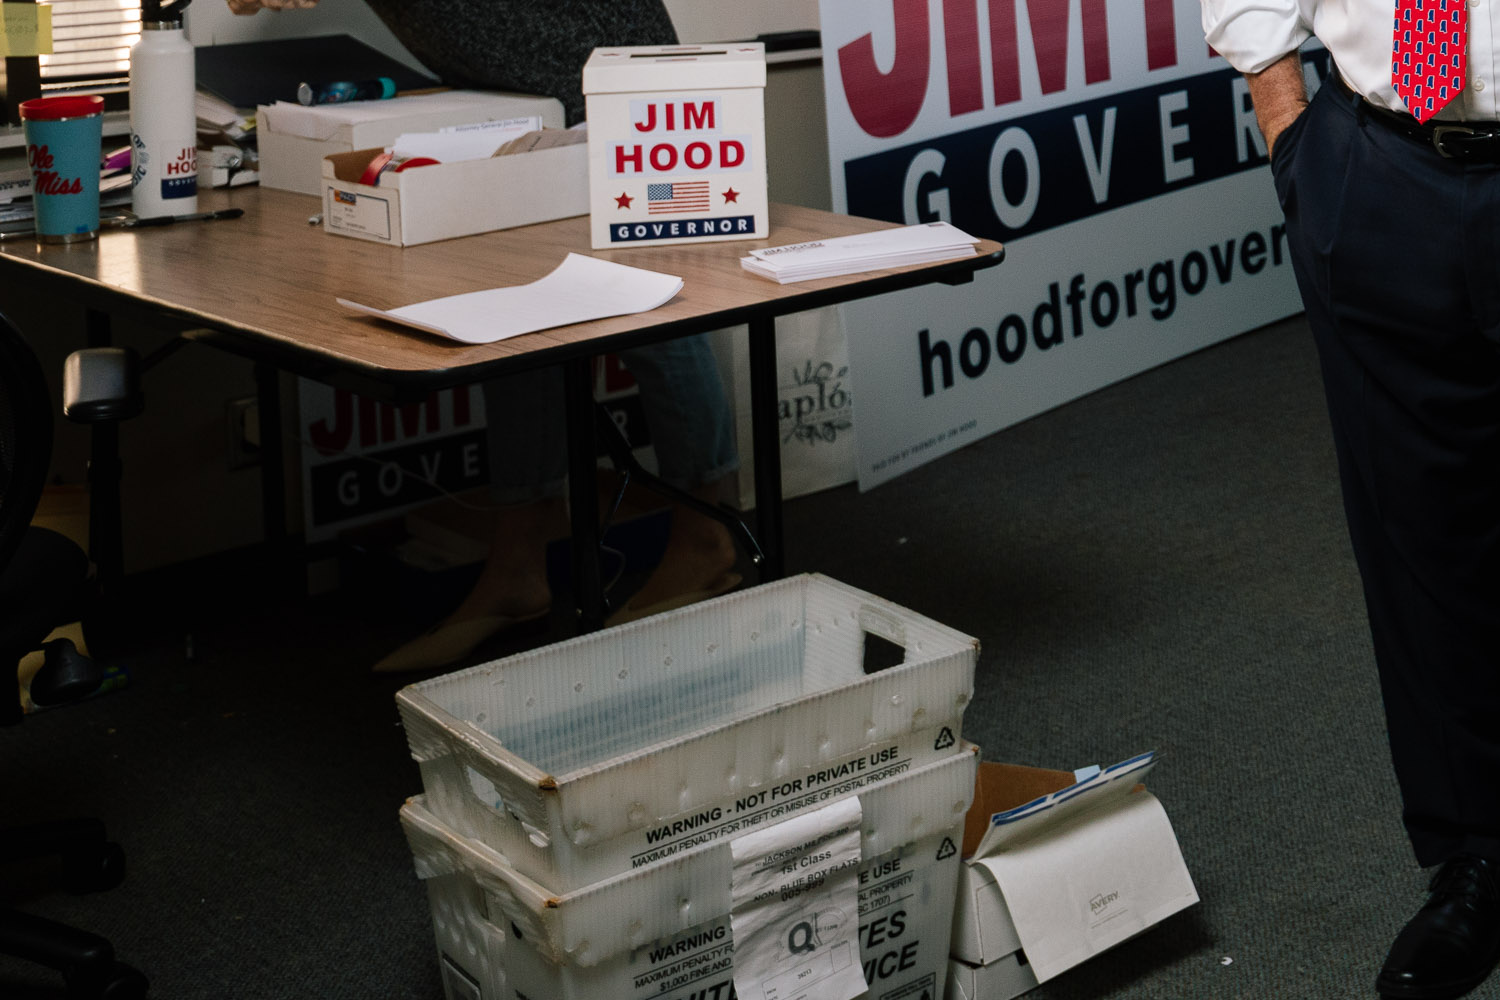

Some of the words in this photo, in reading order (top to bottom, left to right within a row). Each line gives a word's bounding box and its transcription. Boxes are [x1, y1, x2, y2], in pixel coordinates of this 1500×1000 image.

[634, 100, 716, 133] JIM
[28, 144, 55, 169] Ole
[615, 139, 746, 175] HOOD
[33, 170, 83, 196] Miss
[618, 218, 748, 239] GOVERNOR
[646, 807, 722, 845] WARNING
[735, 790, 767, 813] NOT
[771, 778, 802, 800] FOR
[806, 759, 867, 789] PRIVATE
[870, 745, 899, 766] USE
[632, 845, 678, 869] MAXIMUM
[678, 830, 720, 852] PENALTY
[720, 823, 741, 837] FOR
[741, 811, 770, 831] THEFT
[770, 806, 785, 818] OR
[785, 794, 819, 815] MISUSE
[820, 788, 833, 801] OF
[833, 779, 866, 797] POSTAL
[866, 762, 912, 788] PROPERTY
[762, 845, 802, 866] JACKSON
[782, 861, 797, 875] 1st
[800, 850, 832, 868] Class
[780, 877, 805, 892] BLUE
[807, 868, 828, 881] BOX
[829, 857, 859, 875] FLATS
[873, 858, 901, 879] USE
[869, 873, 914, 898] PROPERTY
[1089, 890, 1120, 912] AVERY
[649, 925, 727, 964] WARNING
[634, 964, 681, 989] MAXIMUM
[681, 947, 724, 971] PENALTY
[689, 965, 711, 981] FINE
[711, 957, 732, 973] AND
